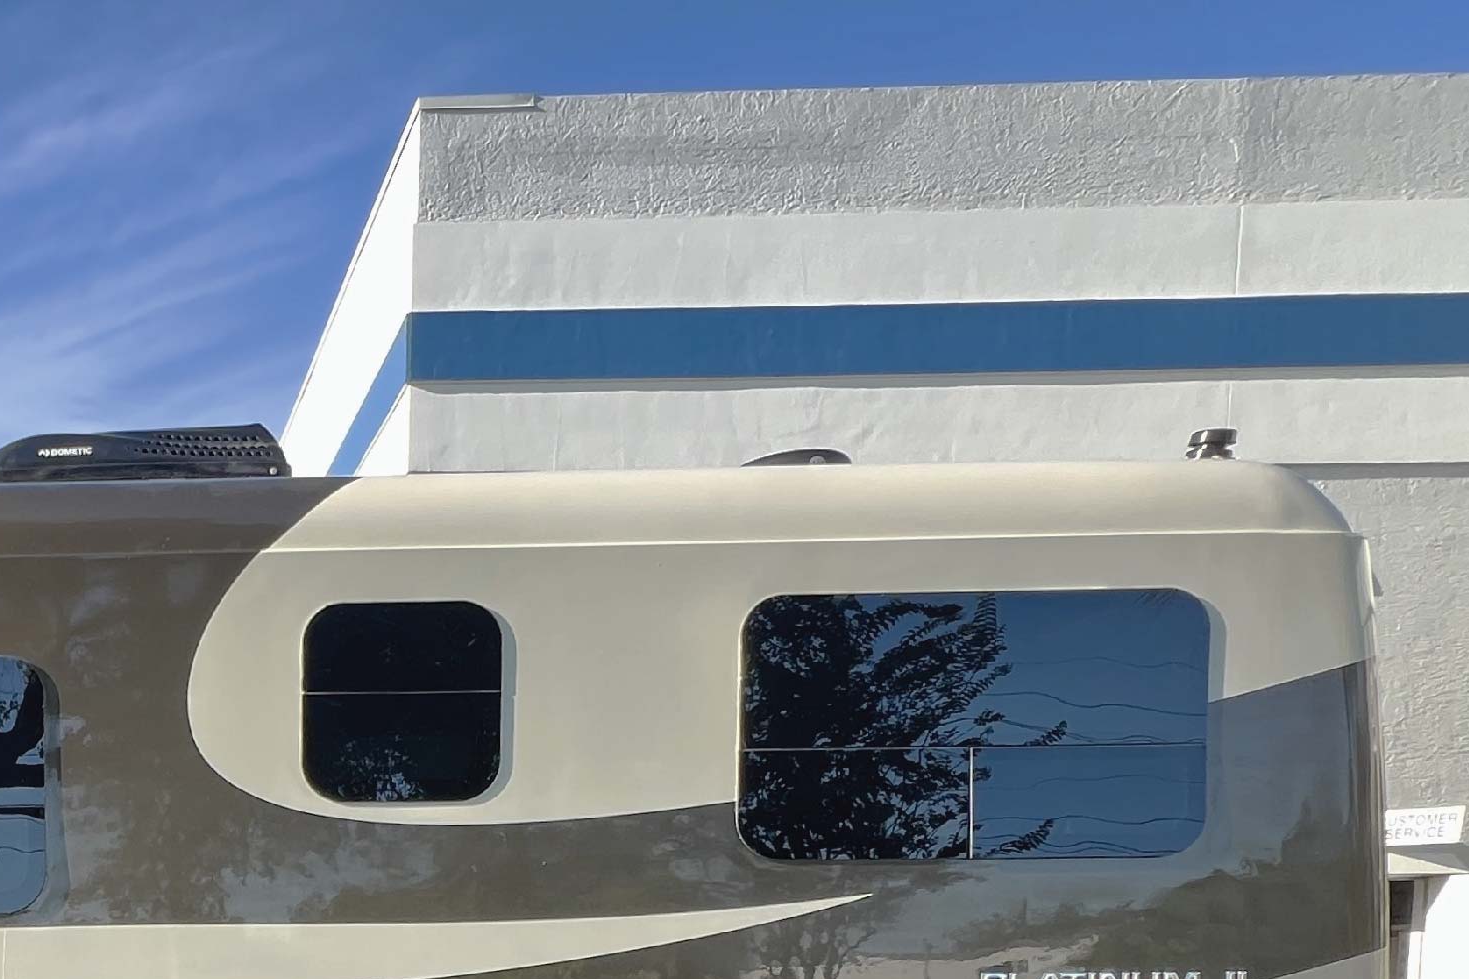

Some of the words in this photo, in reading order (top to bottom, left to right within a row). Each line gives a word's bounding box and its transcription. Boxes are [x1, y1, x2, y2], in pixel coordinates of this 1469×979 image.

[50, 446, 93, 457] DOMETIC
[1386, 813, 1458, 826] USTOMER
[1384, 826, 1445, 840] SERVICE
